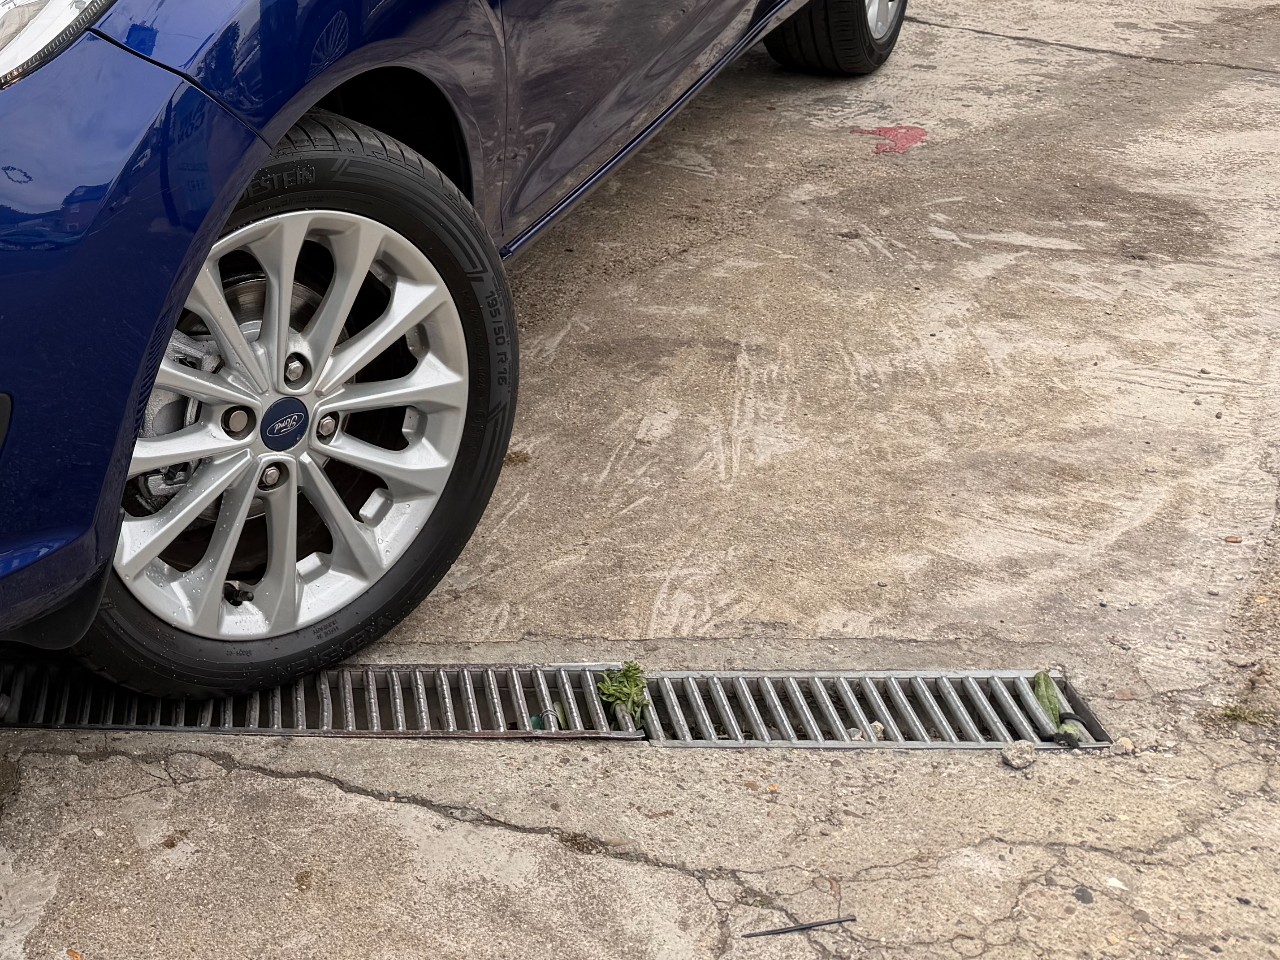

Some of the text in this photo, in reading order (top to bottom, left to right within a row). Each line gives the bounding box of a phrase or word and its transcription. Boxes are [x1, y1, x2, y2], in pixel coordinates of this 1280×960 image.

[240, 167, 316, 199] ESTEIN
[485, 289, 506, 346] 195/50
[273, 414, 298, 433] Ford
